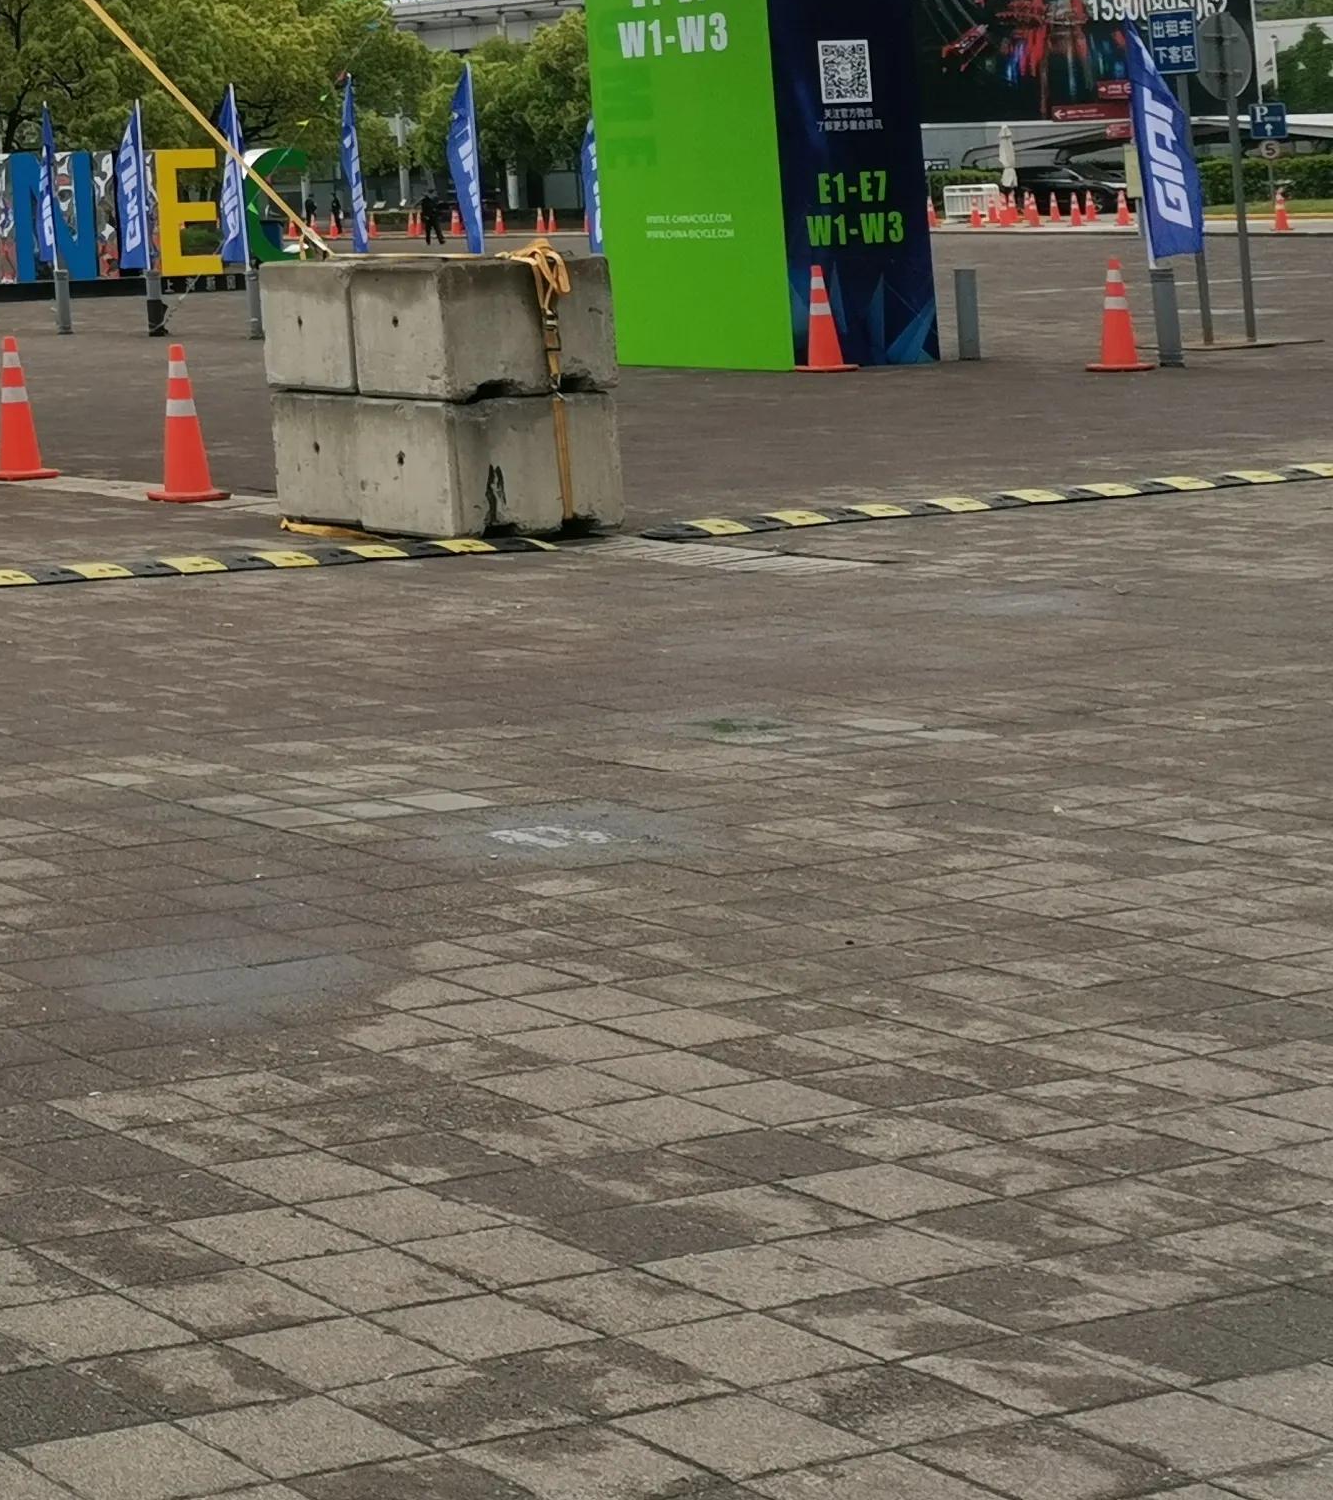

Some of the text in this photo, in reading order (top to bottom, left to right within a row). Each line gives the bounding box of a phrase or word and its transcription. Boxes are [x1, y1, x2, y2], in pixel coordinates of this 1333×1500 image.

[617, 11, 729, 59] W1-W3
[1152, 18, 1193, 38] 出租车
[1153, 45, 1196, 64] 下客区
[1254, 105, 1269, 123] P
[1142, 86, 1194, 229] GIA
[1265, 143, 1277, 157] 5
[817, 169, 889, 205] E1-E7
[805, 210, 906, 247] W1-W3
